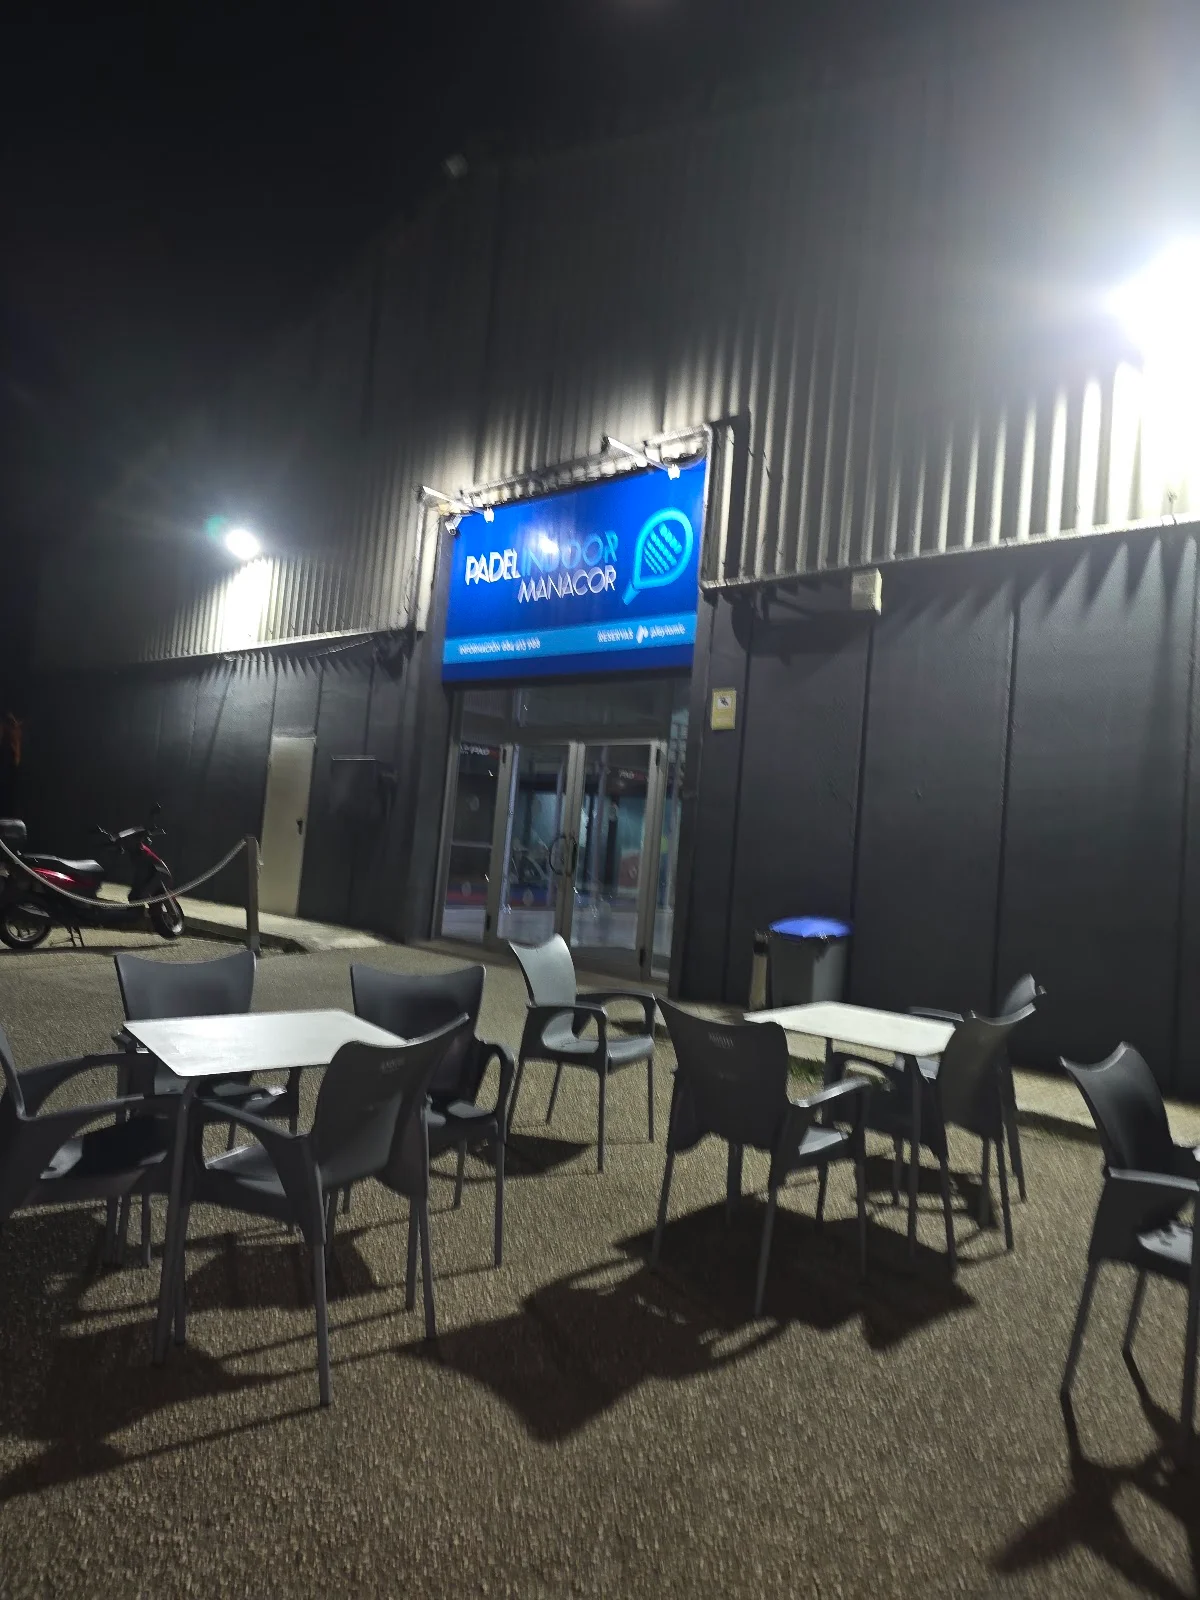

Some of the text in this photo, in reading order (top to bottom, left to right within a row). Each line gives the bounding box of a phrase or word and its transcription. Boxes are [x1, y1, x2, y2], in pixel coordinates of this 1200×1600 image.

[465, 531, 619, 585] PADEL INDOOR
[518, 565, 617, 603] MANACOR
[597, 627, 634, 643] RESERVAS
